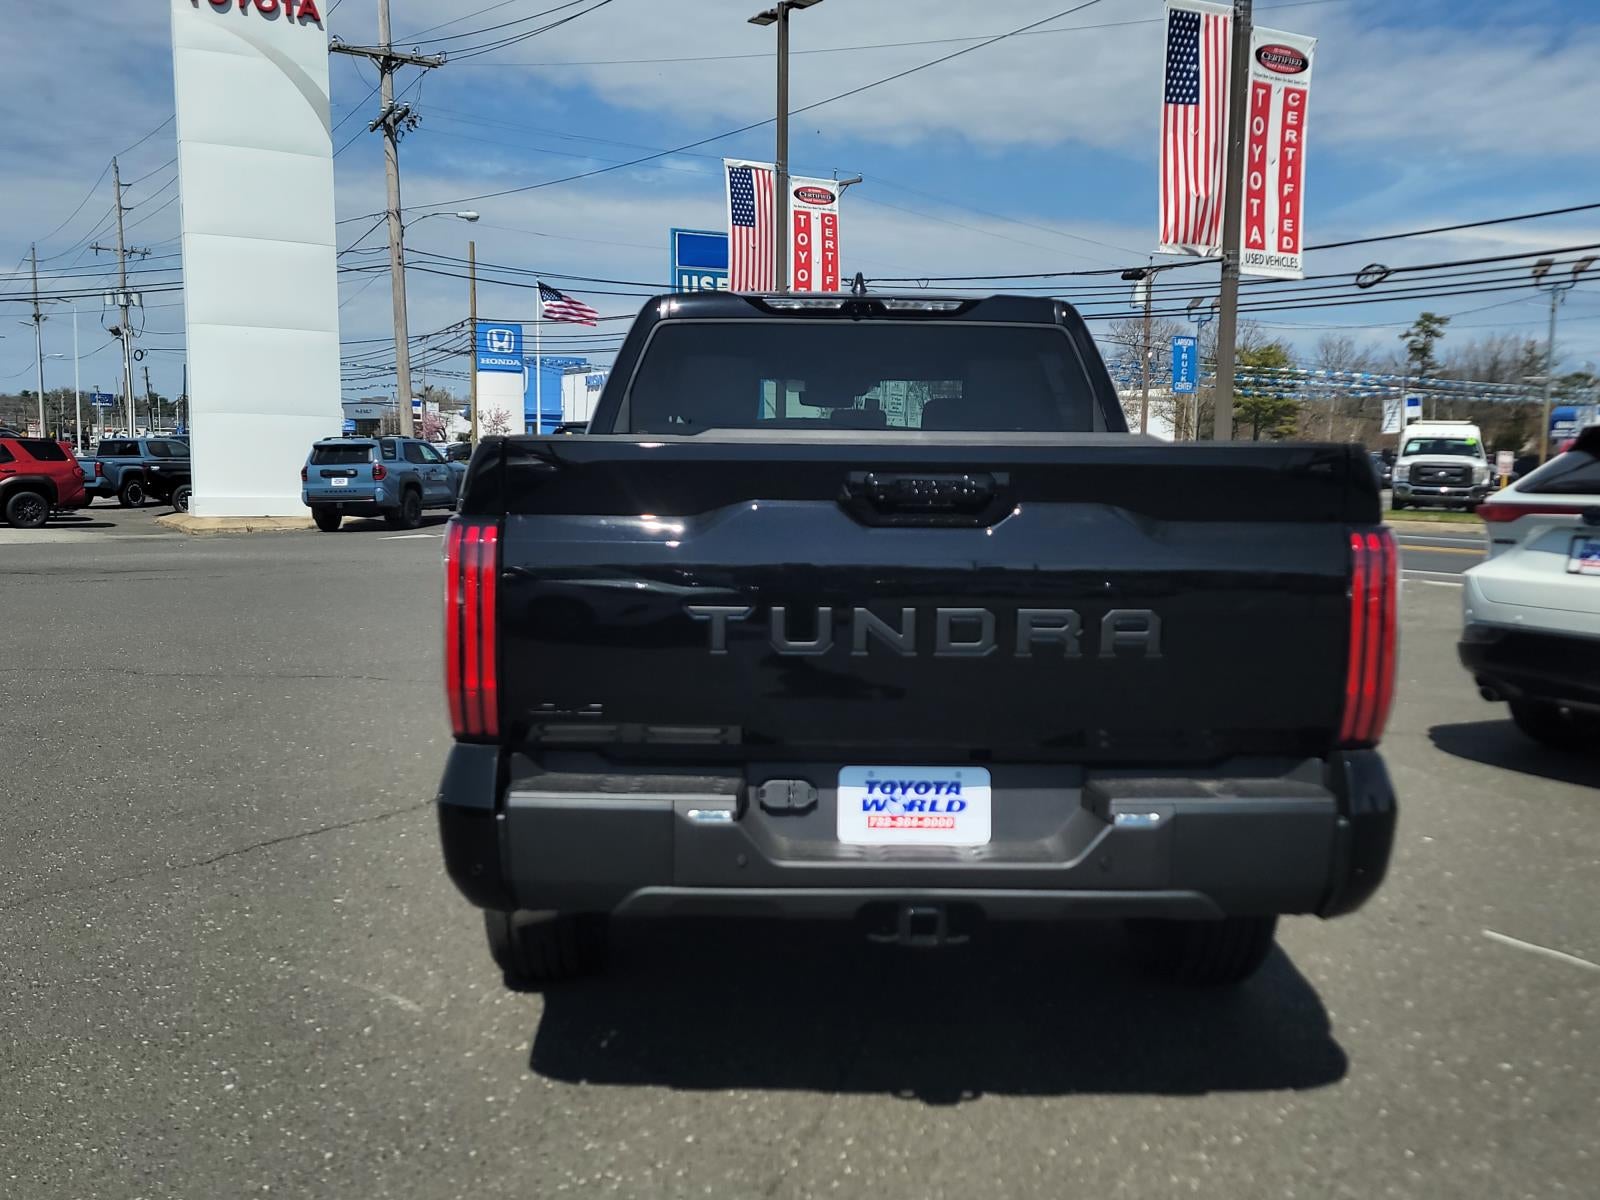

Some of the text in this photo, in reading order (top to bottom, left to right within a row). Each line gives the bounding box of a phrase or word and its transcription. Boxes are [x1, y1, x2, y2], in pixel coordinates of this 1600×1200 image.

[191, 0, 321, 21] OTA
[1261, 51, 1303, 66] CERTIFIED
[1249, 88, 1266, 244] TOYOTA
[1283, 92, 1301, 249] CERTIFIED
[797, 214, 809, 291] TOYO
[824, 216, 834, 292] CERTIF
[1245, 252, 1299, 268] USED VEHICLES
[480, 358, 521, 366] HONDA
[1180, 346, 1188, 382] TRUCK
[687, 605, 1163, 658] TUNDRA
[865, 780, 962, 796] TOYOTA
